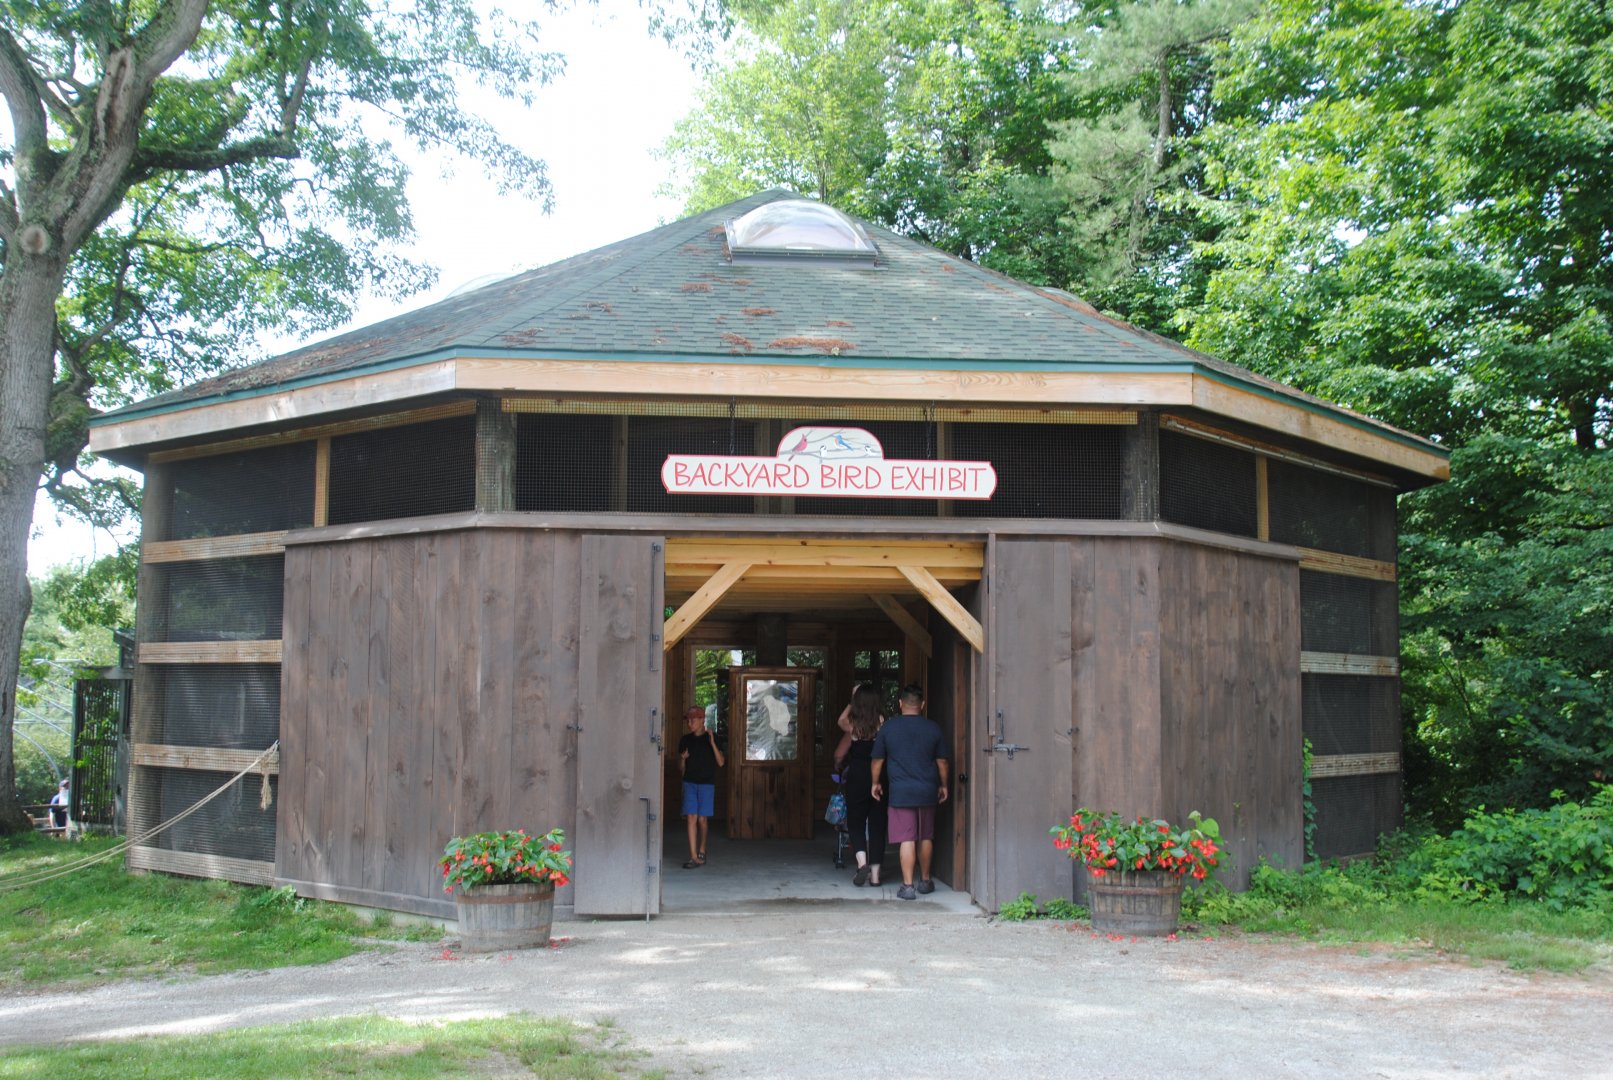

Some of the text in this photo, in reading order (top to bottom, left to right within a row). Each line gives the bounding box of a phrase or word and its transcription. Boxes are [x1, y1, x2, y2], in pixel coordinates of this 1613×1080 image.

[674, 462, 988, 492] BACKYARD BIRD EXHIBIT
